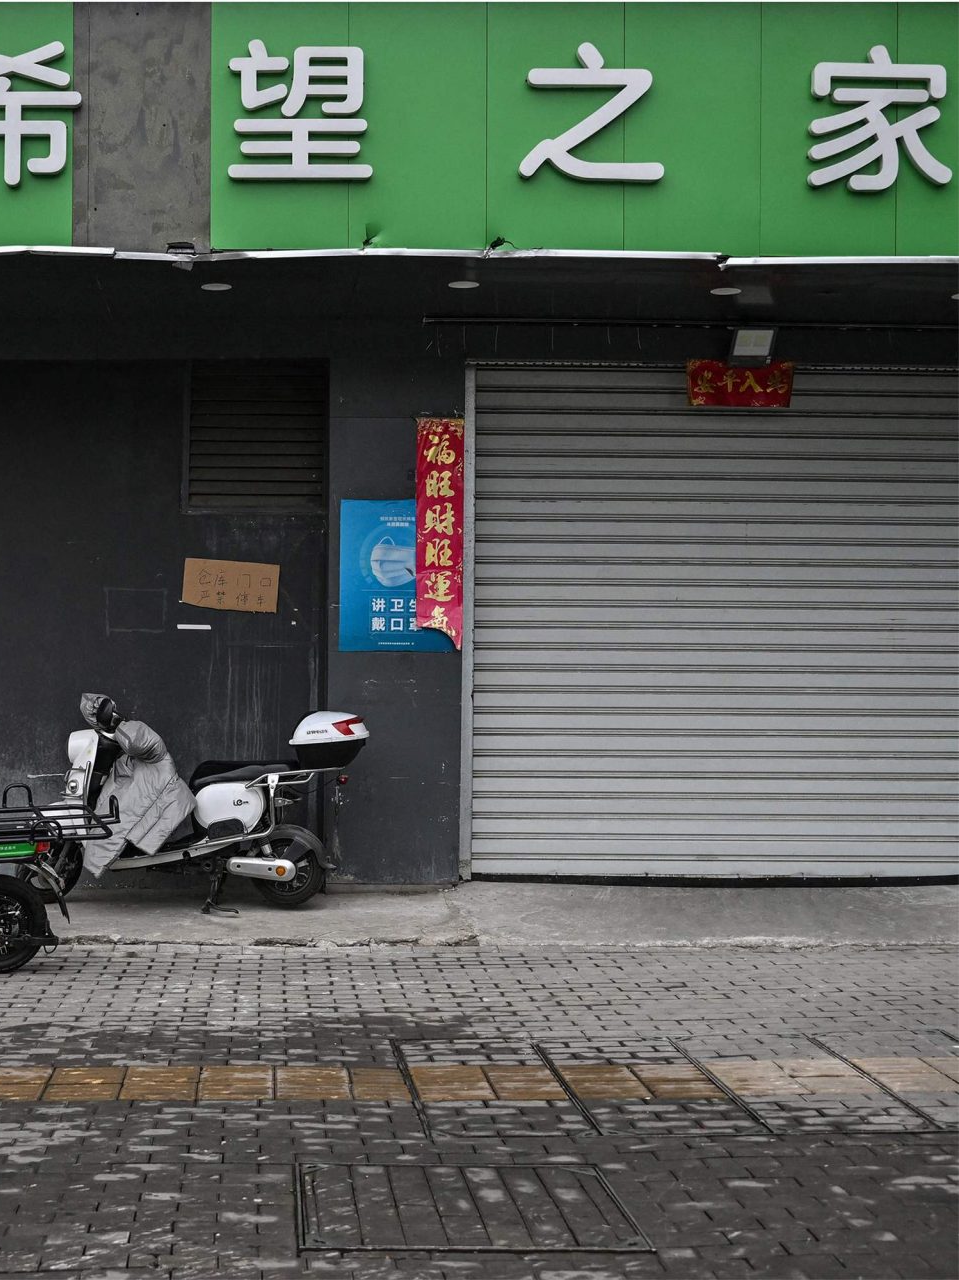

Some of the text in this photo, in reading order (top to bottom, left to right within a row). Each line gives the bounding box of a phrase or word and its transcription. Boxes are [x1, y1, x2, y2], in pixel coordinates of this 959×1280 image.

[197, 568, 272, 588] 仓库门口
[196, 589, 265, 607] 严禁停车
[371, 617, 422, 632] 戴口罩
